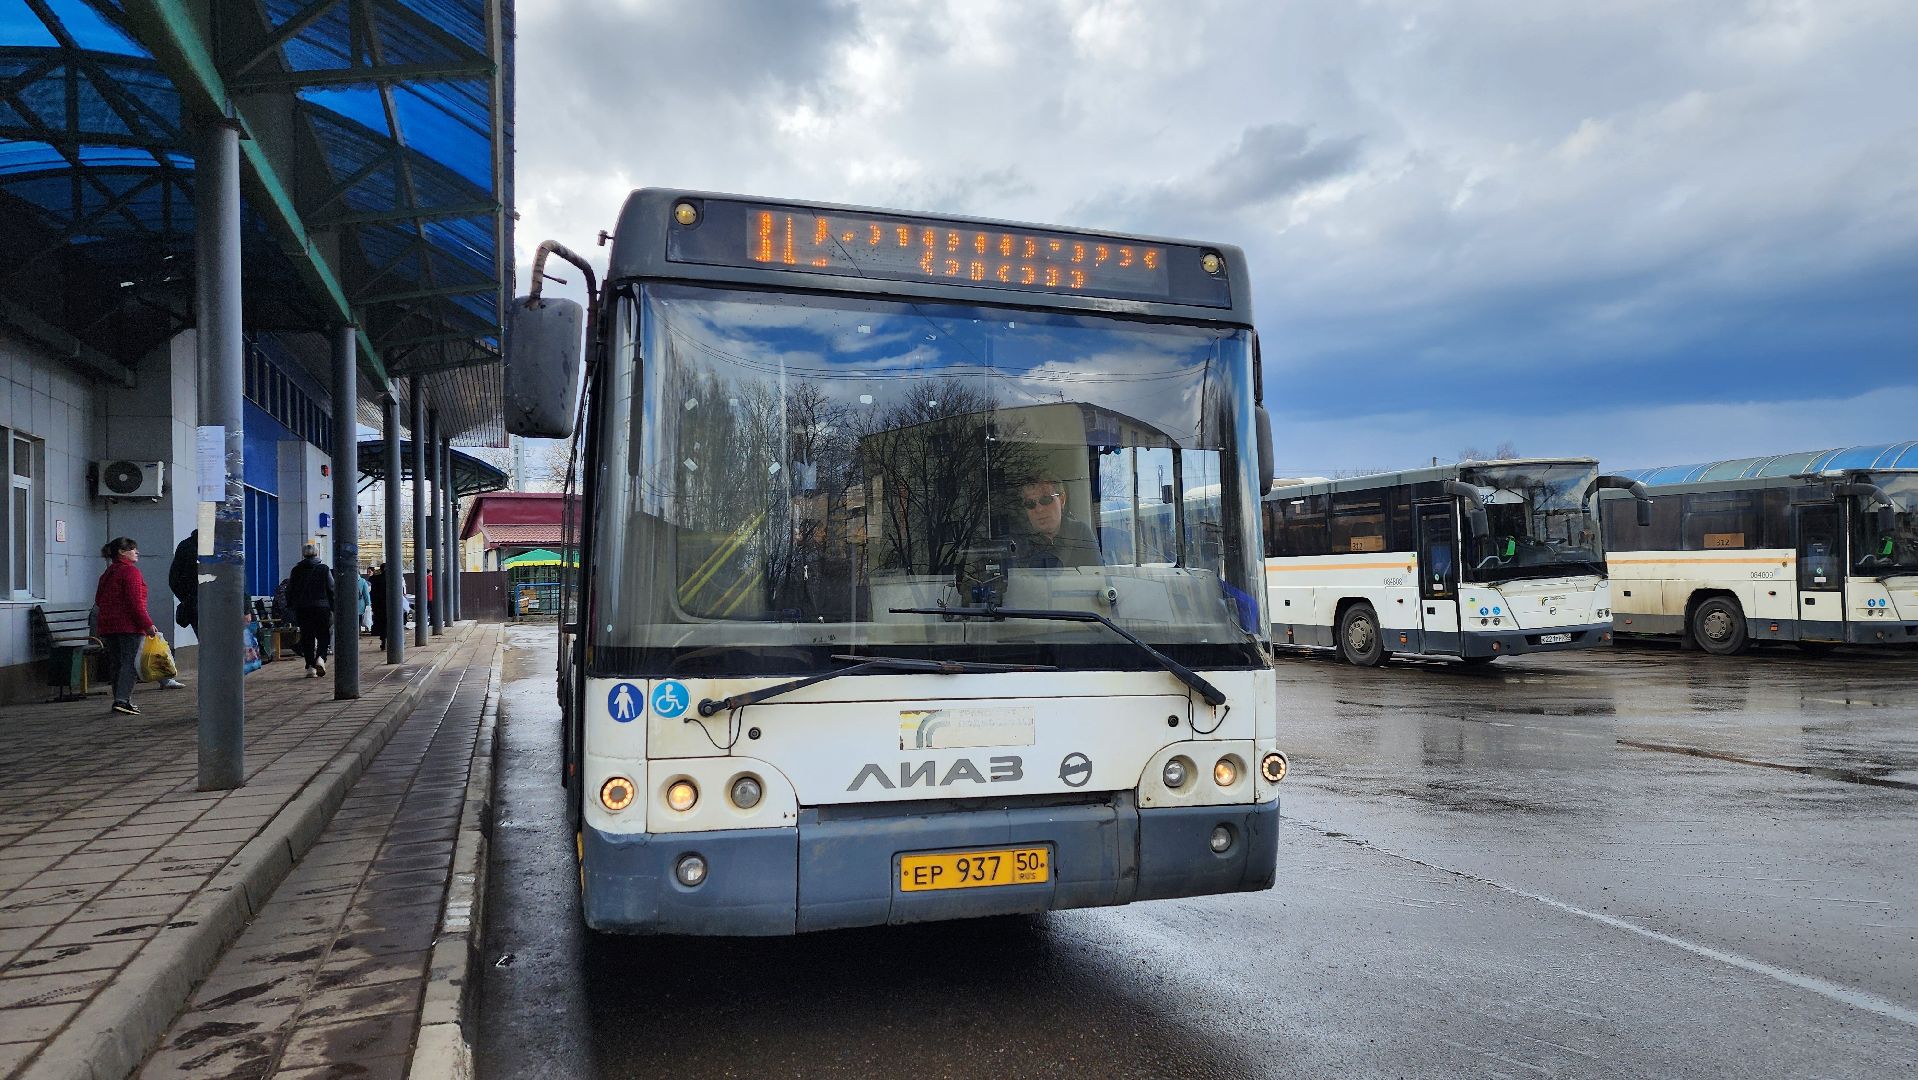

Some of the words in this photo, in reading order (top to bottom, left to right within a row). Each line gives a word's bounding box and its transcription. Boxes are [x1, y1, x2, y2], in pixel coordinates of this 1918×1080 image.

[1352, 542, 1363, 551] 312
[846, 755, 1024, 792] ЛИАЗ
[914, 865, 943, 885] ЕР
[956, 856, 1001, 882] 937
[1016, 852, 1039, 871] 50
